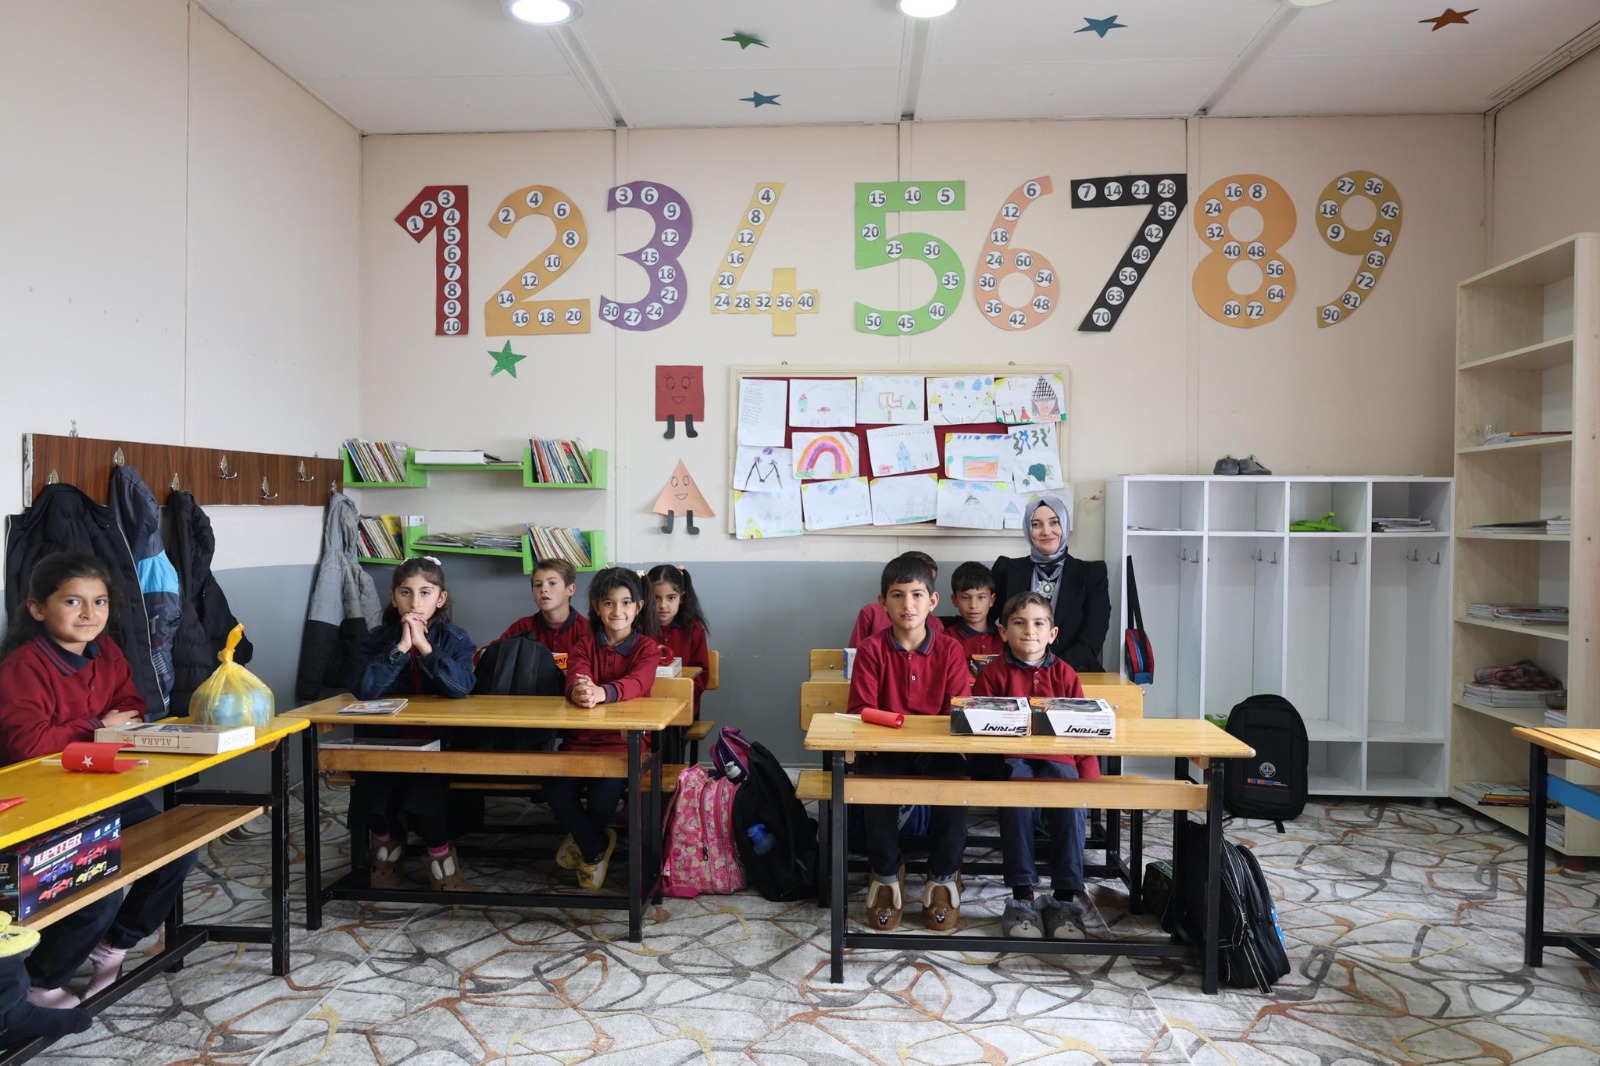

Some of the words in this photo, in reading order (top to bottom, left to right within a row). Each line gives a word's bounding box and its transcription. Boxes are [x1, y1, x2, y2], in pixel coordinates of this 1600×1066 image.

[1026, 183, 1037, 197] 6
[1081, 185, 1092, 199] 7
[1106, 185, 1121, 197] 14
[1133, 184, 1148, 195] 21
[1160, 183, 1174, 195] 28
[1227, 186, 1242, 198] 16
[1252, 184, 1263, 199] 8
[1338, 180, 1354, 193] 27
[1366, 180, 1382, 194] 36
[441, 192, 451, 206] 3
[529, 192, 540, 206] 4
[619, 188, 629, 202] 3
[644, 188, 654, 203] 6
[761, 190, 772, 203] 4
[870, 193, 885, 205] 15
[906, 190, 922, 202] 10
[940, 189, 950, 203] 5
[424, 202, 434, 216] 2
[557, 203, 567, 217] 6
[667, 204, 677, 218] 9
[1004, 206, 1019, 218] 12
[1160, 205, 1175, 217] 35
[1206, 202, 1222, 214] 24
[1322, 204, 1337, 216] 18
[1382, 204, 1398, 218] 45
[446, 210, 456, 223] 4
[502, 208, 512, 223] 2
[750, 209, 761, 223] 8
[410, 218, 420, 231] 1
[447, 228, 456, 242] 5
[663, 231, 678, 243] 12
[739, 232, 754, 244] 12
[864, 226, 879, 238] 20
[992, 230, 1008, 243] 18
[1146, 227, 1161, 239] 42
[1207, 226, 1222, 239] 32
[1329, 225, 1341, 239] 9
[1375, 231, 1390, 244] 54
[565, 232, 576, 246] 8
[394, 185, 468, 336] 1
[484, 185, 591, 337] 2
[599, 181, 693, 331] 3
[710, 182, 819, 336] 4
[855, 180, 965, 336] 5
[976, 175, 1060, 331] 6
[1071, 173, 1187, 332] 7
[1192, 173, 1297, 329] 8
[1315, 170, 1403, 329] 9
[447, 247, 457, 261] 6
[887, 243, 902, 255] 25
[925, 244, 940, 256] 30
[1133, 248, 1148, 261] 49
[1224, 245, 1240, 257] 40
[1248, 246, 1264, 257] 48
[546, 256, 561, 268] 10
[643, 251, 658, 263] 15
[729, 253, 744, 264] 16
[987, 254, 1002, 266] 24
[1016, 255, 1032, 267] 60
[1368, 253, 1383, 267] 63
[448, 265, 457, 279] 7
[660, 268, 674, 280] 18
[1120, 270, 1136, 282] 56
[1268, 264, 1283, 276] 56
[523, 275, 537, 287] 12
[720, 274, 734, 286] 20
[944, 274, 958, 286] 35
[980, 276, 995, 288] 30
[1037, 272, 1052, 284] 54
[1358, 274, 1373, 288] 72
[447, 283, 457, 297] 8
[662, 288, 676, 301] 21
[1107, 290, 1123, 302] 63
[1268, 288, 1284, 300] 64
[499, 293, 514, 304] 14
[715, 296, 730, 307] 24
[735, 297, 750, 309] 28
[756, 296, 771, 308] 32
[778, 296, 792, 308] 36
[798, 296, 814, 308] 40
[1034, 298, 1049, 311] 48
[1344, 294, 1358, 308] 81
[447, 301, 457, 315] 9
[604, 305, 619, 318] 30
[647, 304, 662, 317] 24
[930, 305, 945, 317] 40
[986, 302, 1001, 314] 36
[1224, 304, 1240, 316] 80
[1248, 305, 1263, 317] 72
[514, 312, 528, 324] 16
[540, 312, 554, 323] 18
[566, 310, 582, 321] 20
[625, 310, 640, 323] 27
[866, 315, 882, 327] 50
[1010, 314, 1026, 325] 42
[1094, 312, 1110, 323] 70
[1324, 308, 1339, 322] 90
[445, 320, 460, 332] 10
[898, 318, 914, 329] 45
[981, 723, 1028, 734] SPRINT
[1064, 724, 1112, 736] SPRINT
[141, 737, 172, 746] ALARA
[31, 832, 82, 870] JUPITER
